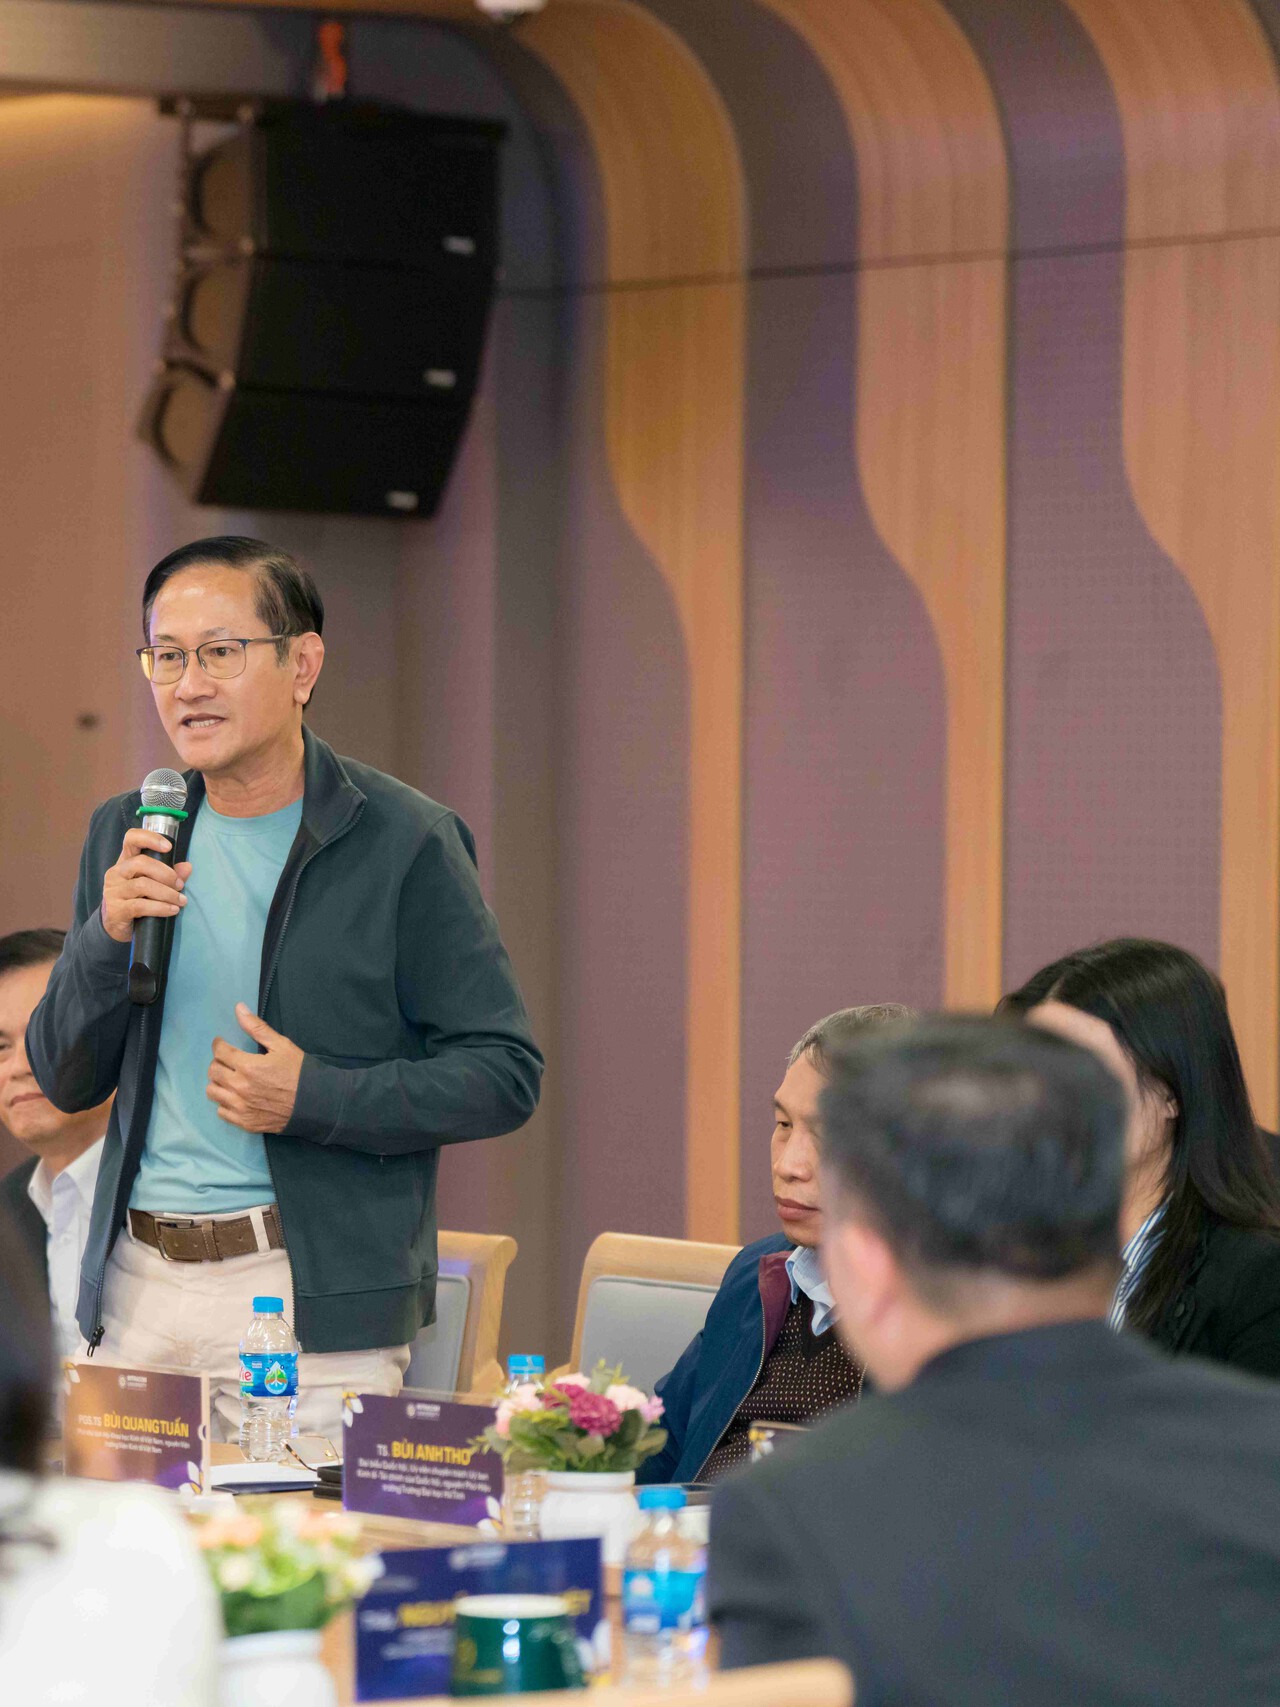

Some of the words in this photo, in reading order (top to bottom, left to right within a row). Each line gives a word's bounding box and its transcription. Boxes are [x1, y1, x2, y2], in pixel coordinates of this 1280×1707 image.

[103, 1411, 121, 1429] BÙI
[122, 1415, 159, 1434] QUANG
[160, 1416, 189, 1438] TUẤN
[391, 1438, 415, 1459] BÙI
[415, 1443, 443, 1463] ANH
